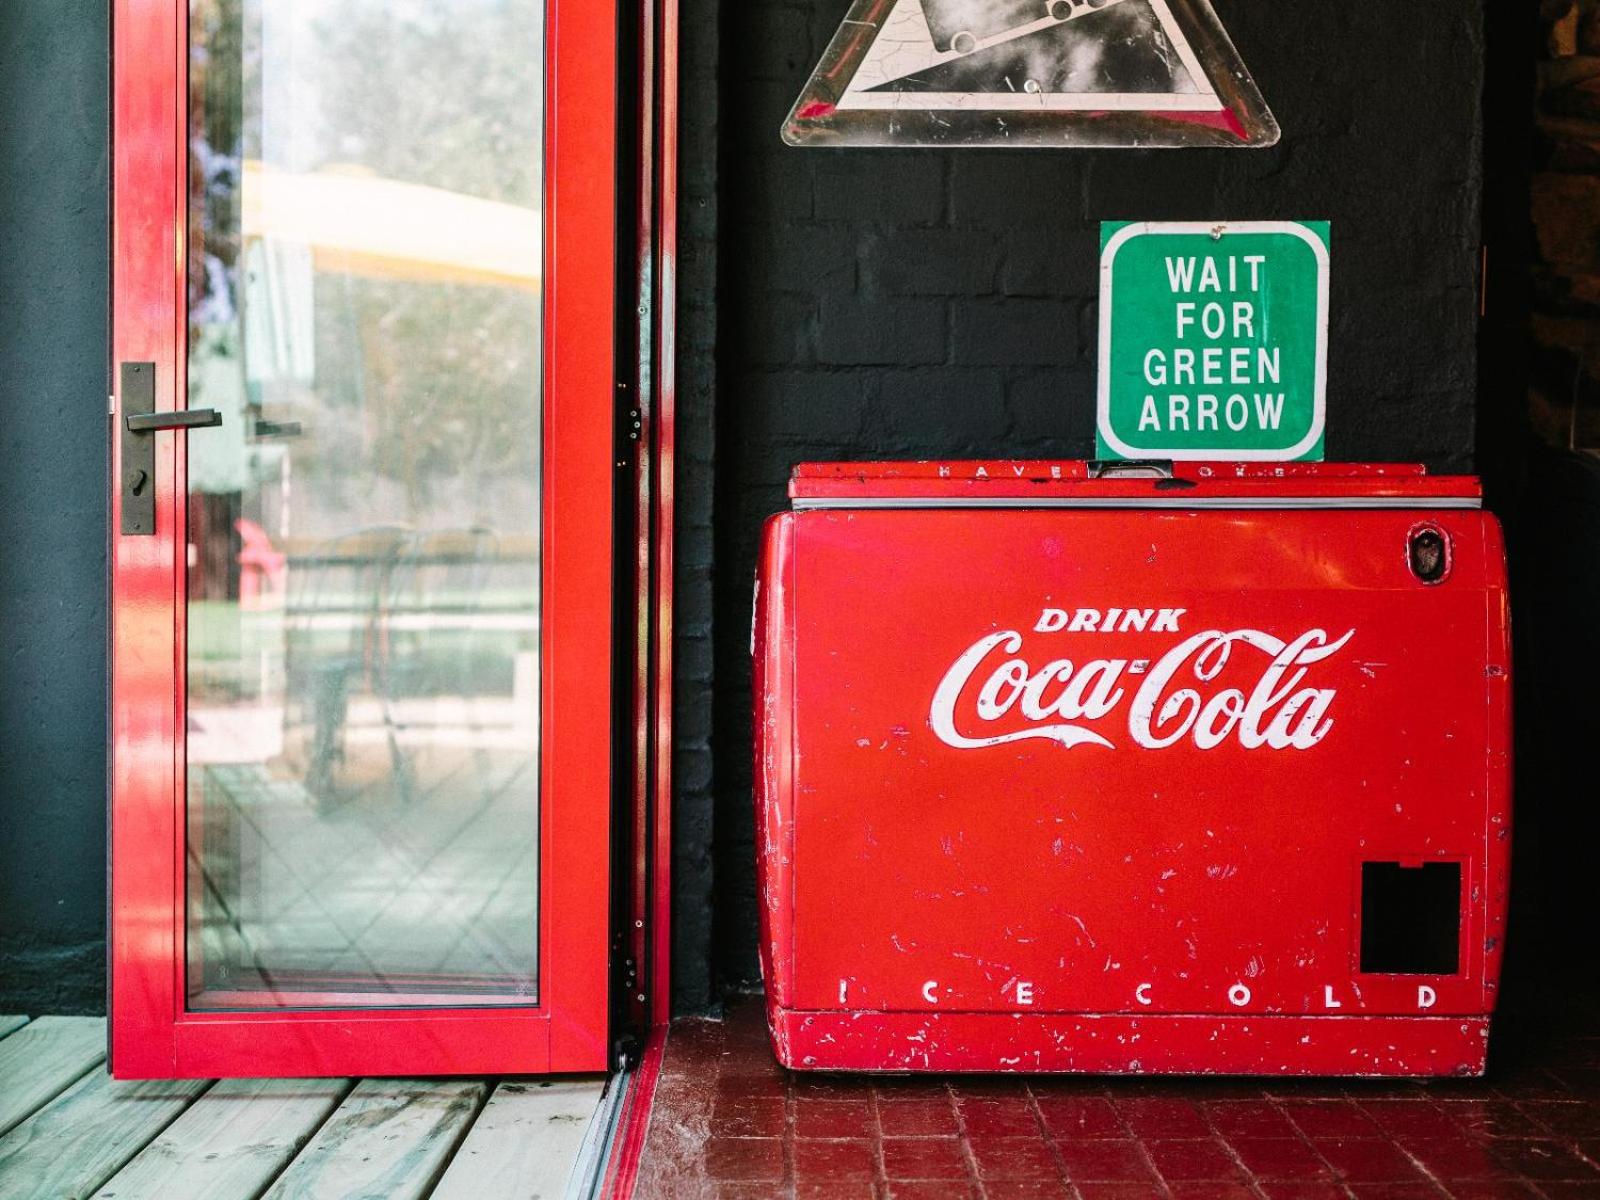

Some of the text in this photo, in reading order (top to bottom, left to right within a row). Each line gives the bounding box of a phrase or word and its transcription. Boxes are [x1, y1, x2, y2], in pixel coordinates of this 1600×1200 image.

[1165, 255, 1265, 292] WAIT
[1176, 302, 1254, 339] FOR
[1143, 347, 1280, 385] GREEN
[1138, 393, 1285, 431] ARROW
[939, 465, 1061, 479] HAVE
[1033, 608, 1187, 633] DRINK
[929, 628, 1356, 750] Coca-Cola
[839, 979, 1436, 1009] ICE COLD
